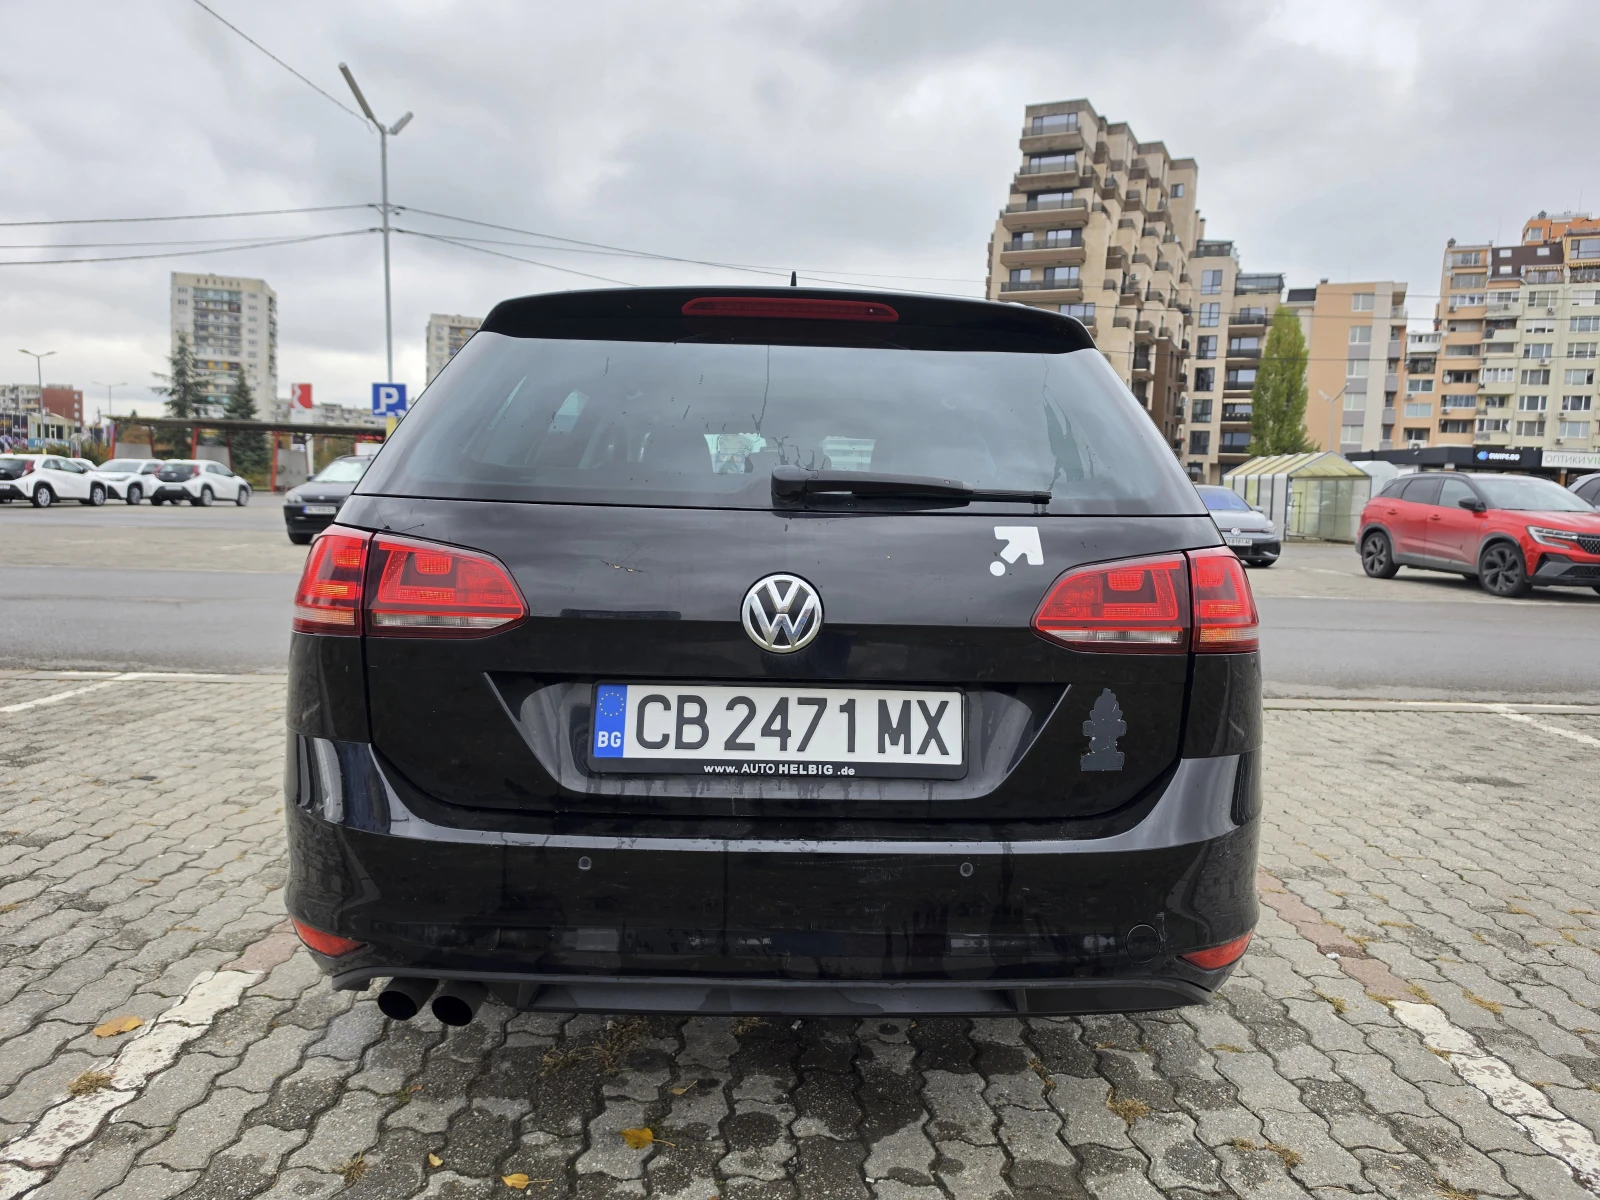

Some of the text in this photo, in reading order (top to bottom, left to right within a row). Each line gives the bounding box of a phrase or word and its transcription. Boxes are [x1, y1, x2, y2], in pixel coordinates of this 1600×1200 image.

[379, 386, 399, 413] P
[1545, 454, 1586, 463] ОПТИКИ
[635, 694, 950, 756] CB 2471 MX
[597, 731, 621, 748] BG
[703, 764, 738, 773] www.
[740, 763, 776, 774] AUTO
[778, 764, 834, 775] HELBIG
